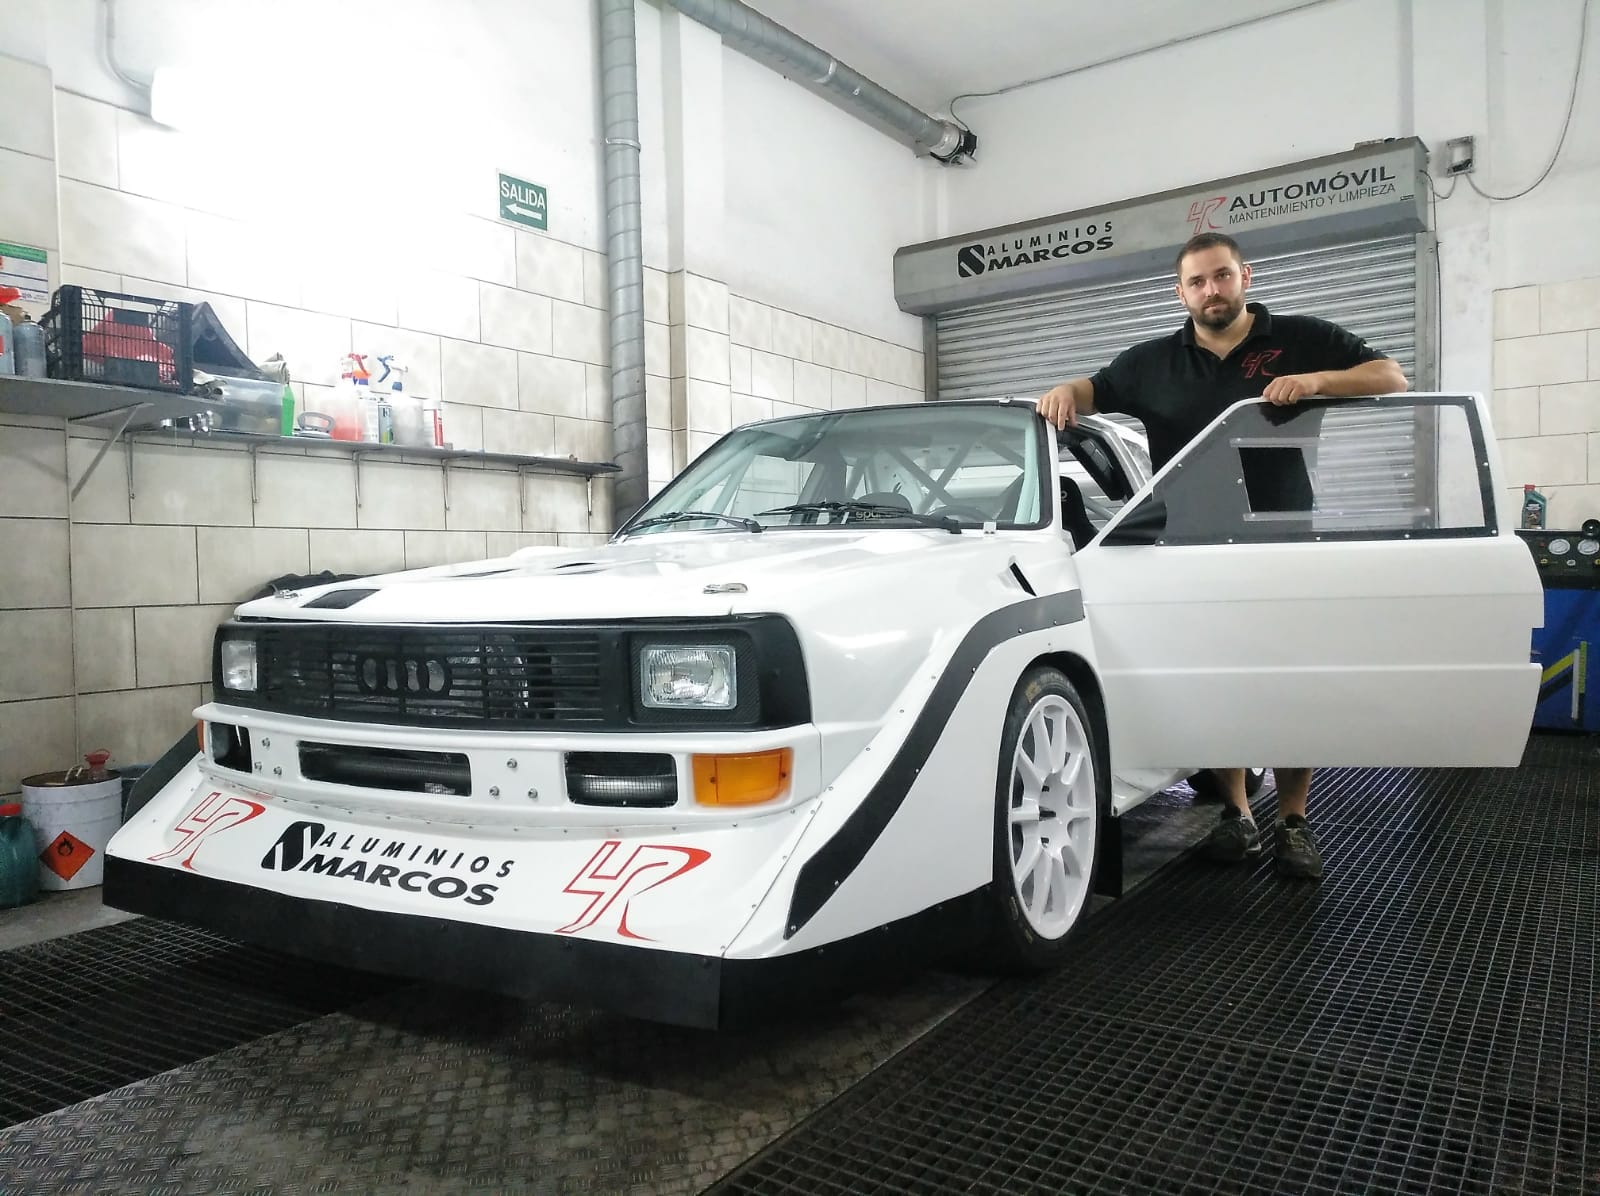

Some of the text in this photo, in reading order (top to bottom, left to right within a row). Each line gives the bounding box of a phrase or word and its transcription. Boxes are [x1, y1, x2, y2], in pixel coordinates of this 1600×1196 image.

[500, 181, 546, 210] SALIDA
[1229, 166, 1396, 212] AUTOMÓVIL
[1229, 183, 1396, 225] MANTENIMIENTO Y LIMPIEZA
[987, 221, 1113, 256] ALUMINIOS
[988, 236, 1114, 272] MARCOS
[319, 831, 515, 879] ALUMINIOS
[299, 853, 500, 906] MARCOS
